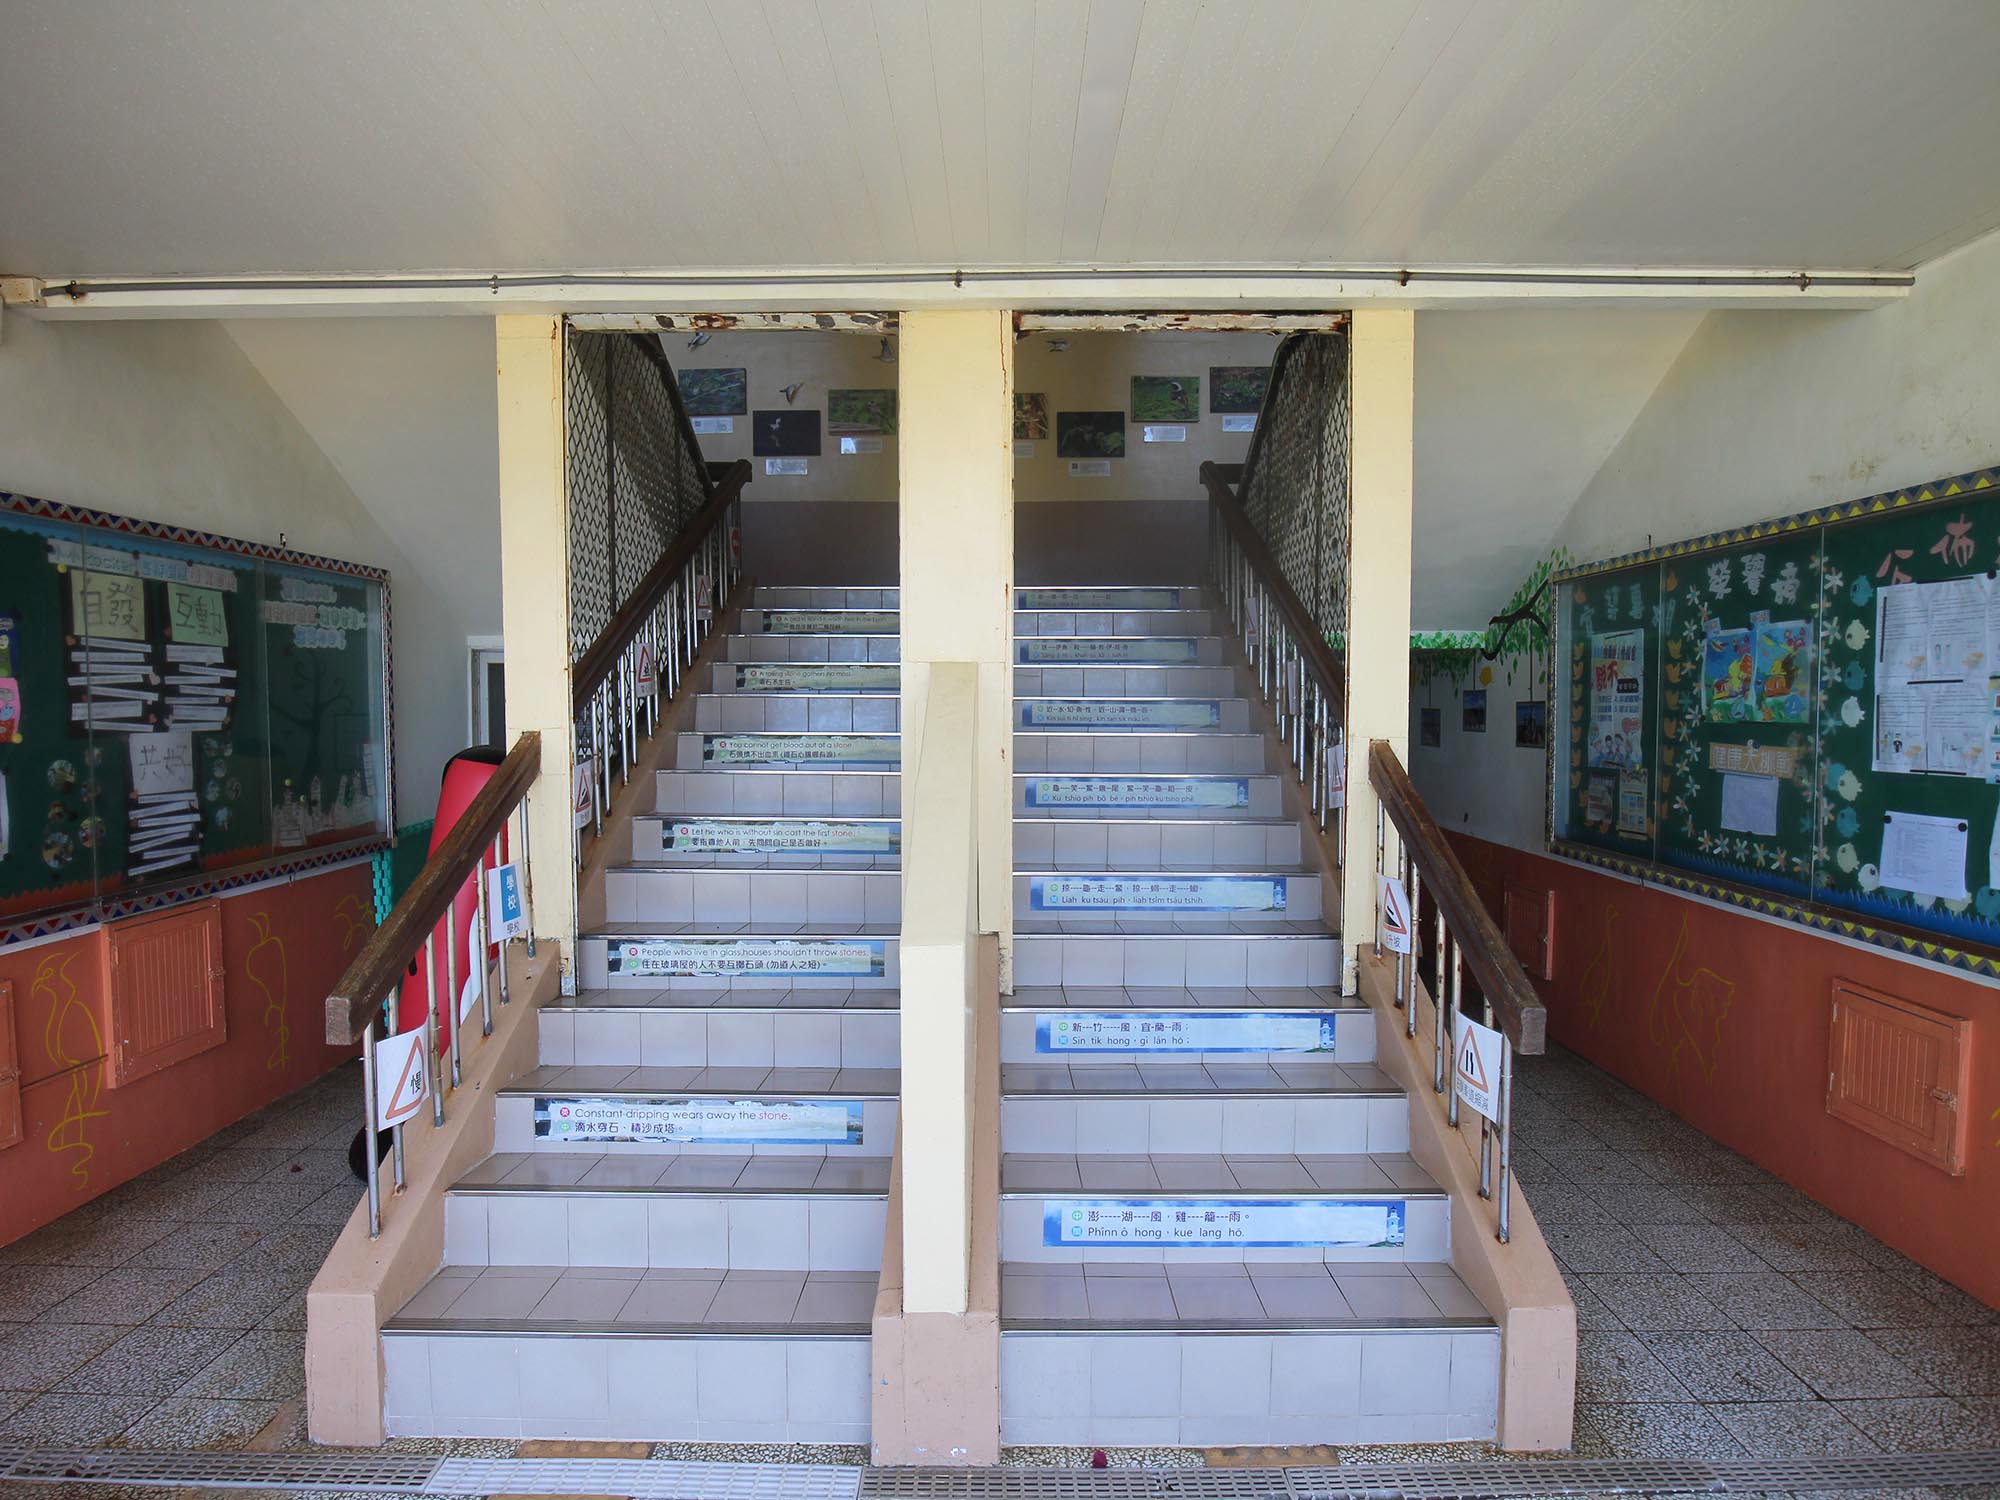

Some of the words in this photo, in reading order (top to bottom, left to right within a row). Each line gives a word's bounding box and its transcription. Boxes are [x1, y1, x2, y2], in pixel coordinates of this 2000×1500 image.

[691, 828, 704, 836] Let
[705, 828, 715, 836] he
[718, 828, 734, 836] who
[735, 828, 741, 836] is
[743, 828, 772, 836] without
[773, 828, 783, 836] sin
[784, 828, 801, 837] cast
[803, 828, 816, 837] the
[817, 828, 830, 837] first
[505, 873, 517, 911] 學校
[641, 948, 672, 958] People
[674, 948, 692, 956] who
[694, 948, 708, 956] live
[710, 948, 719, 956] in
[773, 948, 811, 956] shouldn't
[813, 948, 838, 957] throw
[1072, 1036, 1086, 1045] Sin
[574, 1109, 623, 1118] Constant
[625, 1109, 670, 1121] dripping
[672, 1111, 704, 1119] wears
[706, 1111, 737, 1121] away
[739, 1111, 757, 1119] the
[759, 1111, 791, 1120] stone.
[1088, 1227, 1118, 1237] Phînn
[1174, 1227, 1193, 1237] kue
[1199, 1227, 1222, 1240] lang
